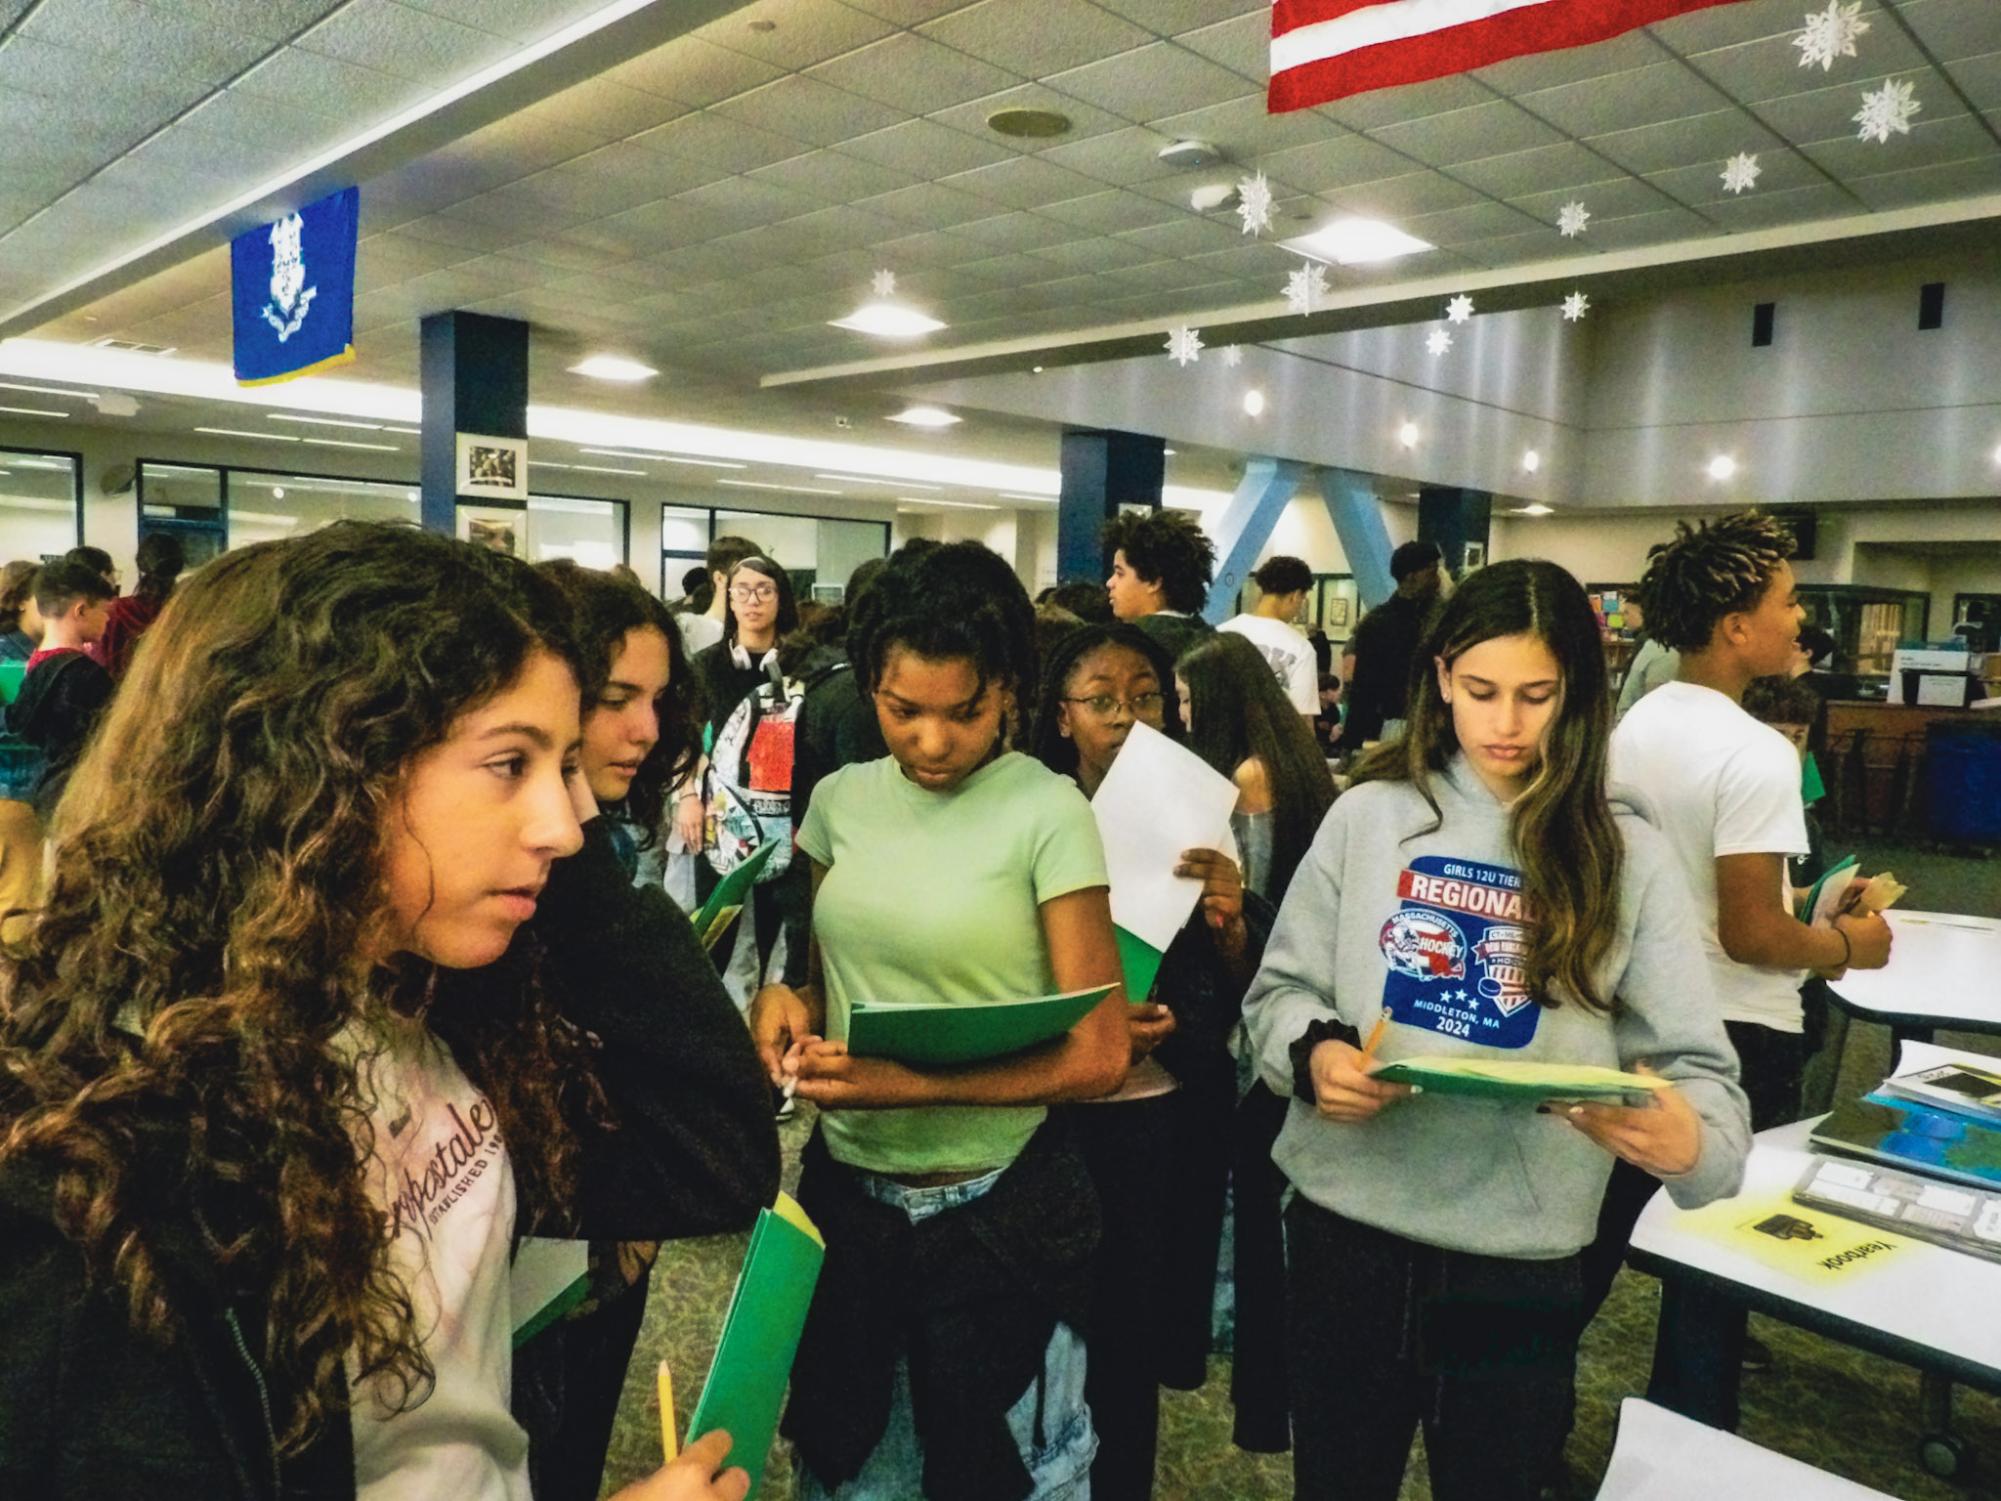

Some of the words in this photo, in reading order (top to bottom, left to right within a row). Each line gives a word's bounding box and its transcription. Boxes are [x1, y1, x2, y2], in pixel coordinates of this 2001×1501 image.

[1443, 863, 1474, 879] GIRLS
[1476, 870, 1496, 884] 12U
[1420, 936, 1465, 959] HOCKEY
[1413, 999, 1479, 1025] MIDDLETON,
[1482, 1017, 1500, 1029] MA
[1436, 1015, 1471, 1038] 2024
[1816, 1240, 1898, 1270] Yearbook
